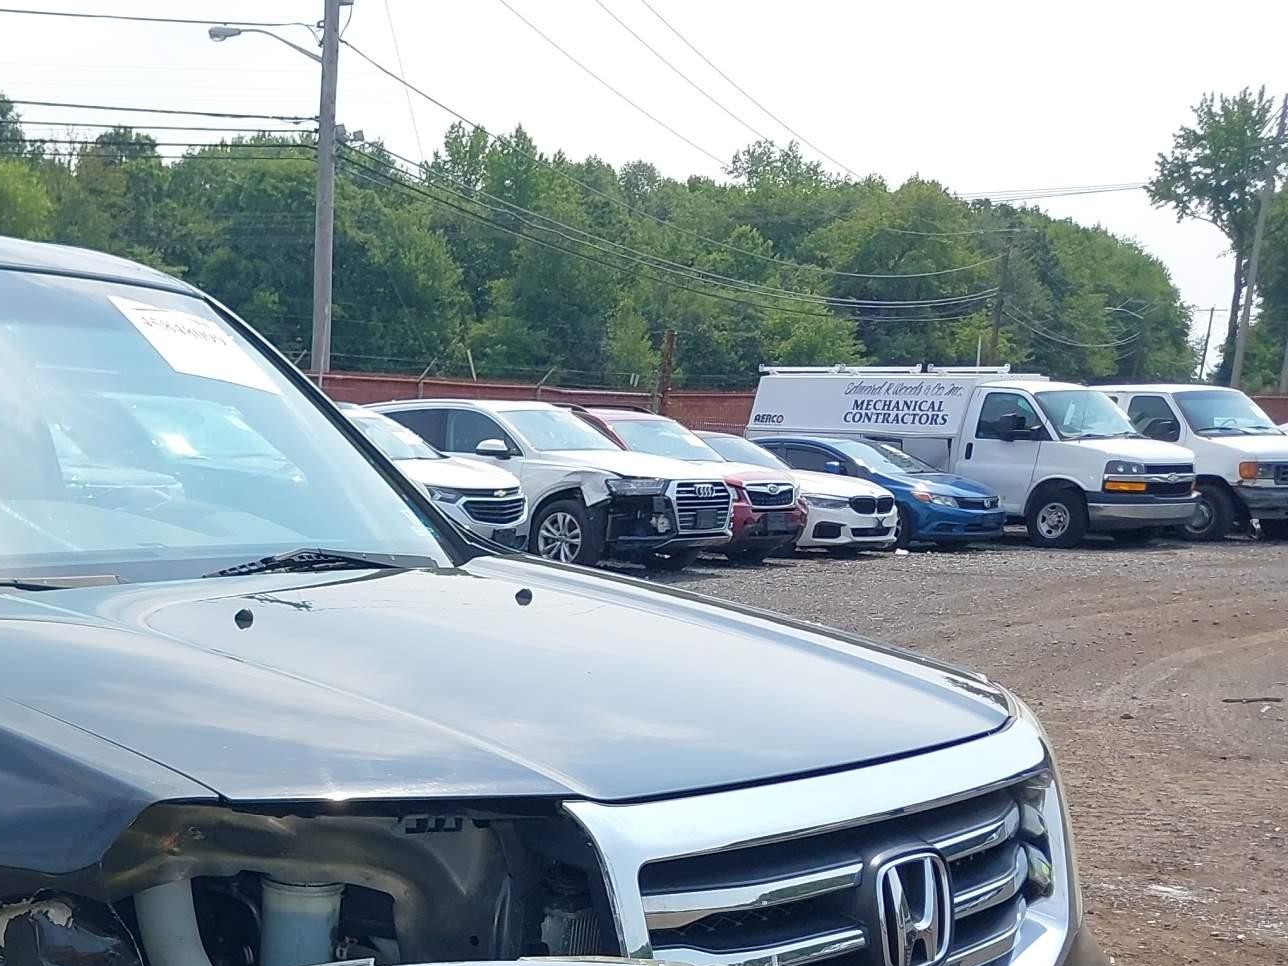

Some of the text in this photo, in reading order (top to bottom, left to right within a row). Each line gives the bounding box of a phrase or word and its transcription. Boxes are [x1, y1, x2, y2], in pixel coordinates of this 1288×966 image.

[852, 399, 945, 412] MECHANICAL
[753, 413, 785, 424] AERCO
[843, 411, 949, 425] CONTRACTORS
